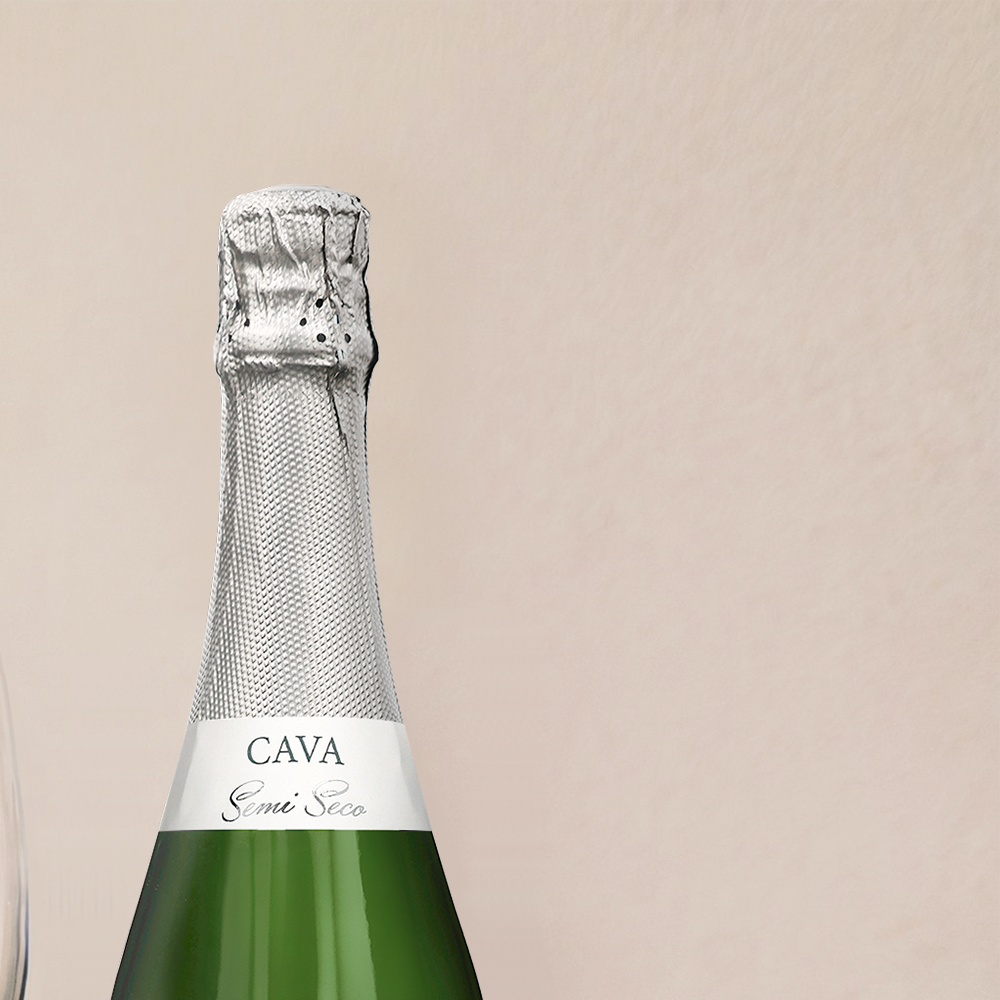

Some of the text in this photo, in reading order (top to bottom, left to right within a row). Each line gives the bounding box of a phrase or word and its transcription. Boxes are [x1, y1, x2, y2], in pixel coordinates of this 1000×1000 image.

[246, 735, 346, 766] CAVA
[221, 779, 368, 823] Semi Seco
